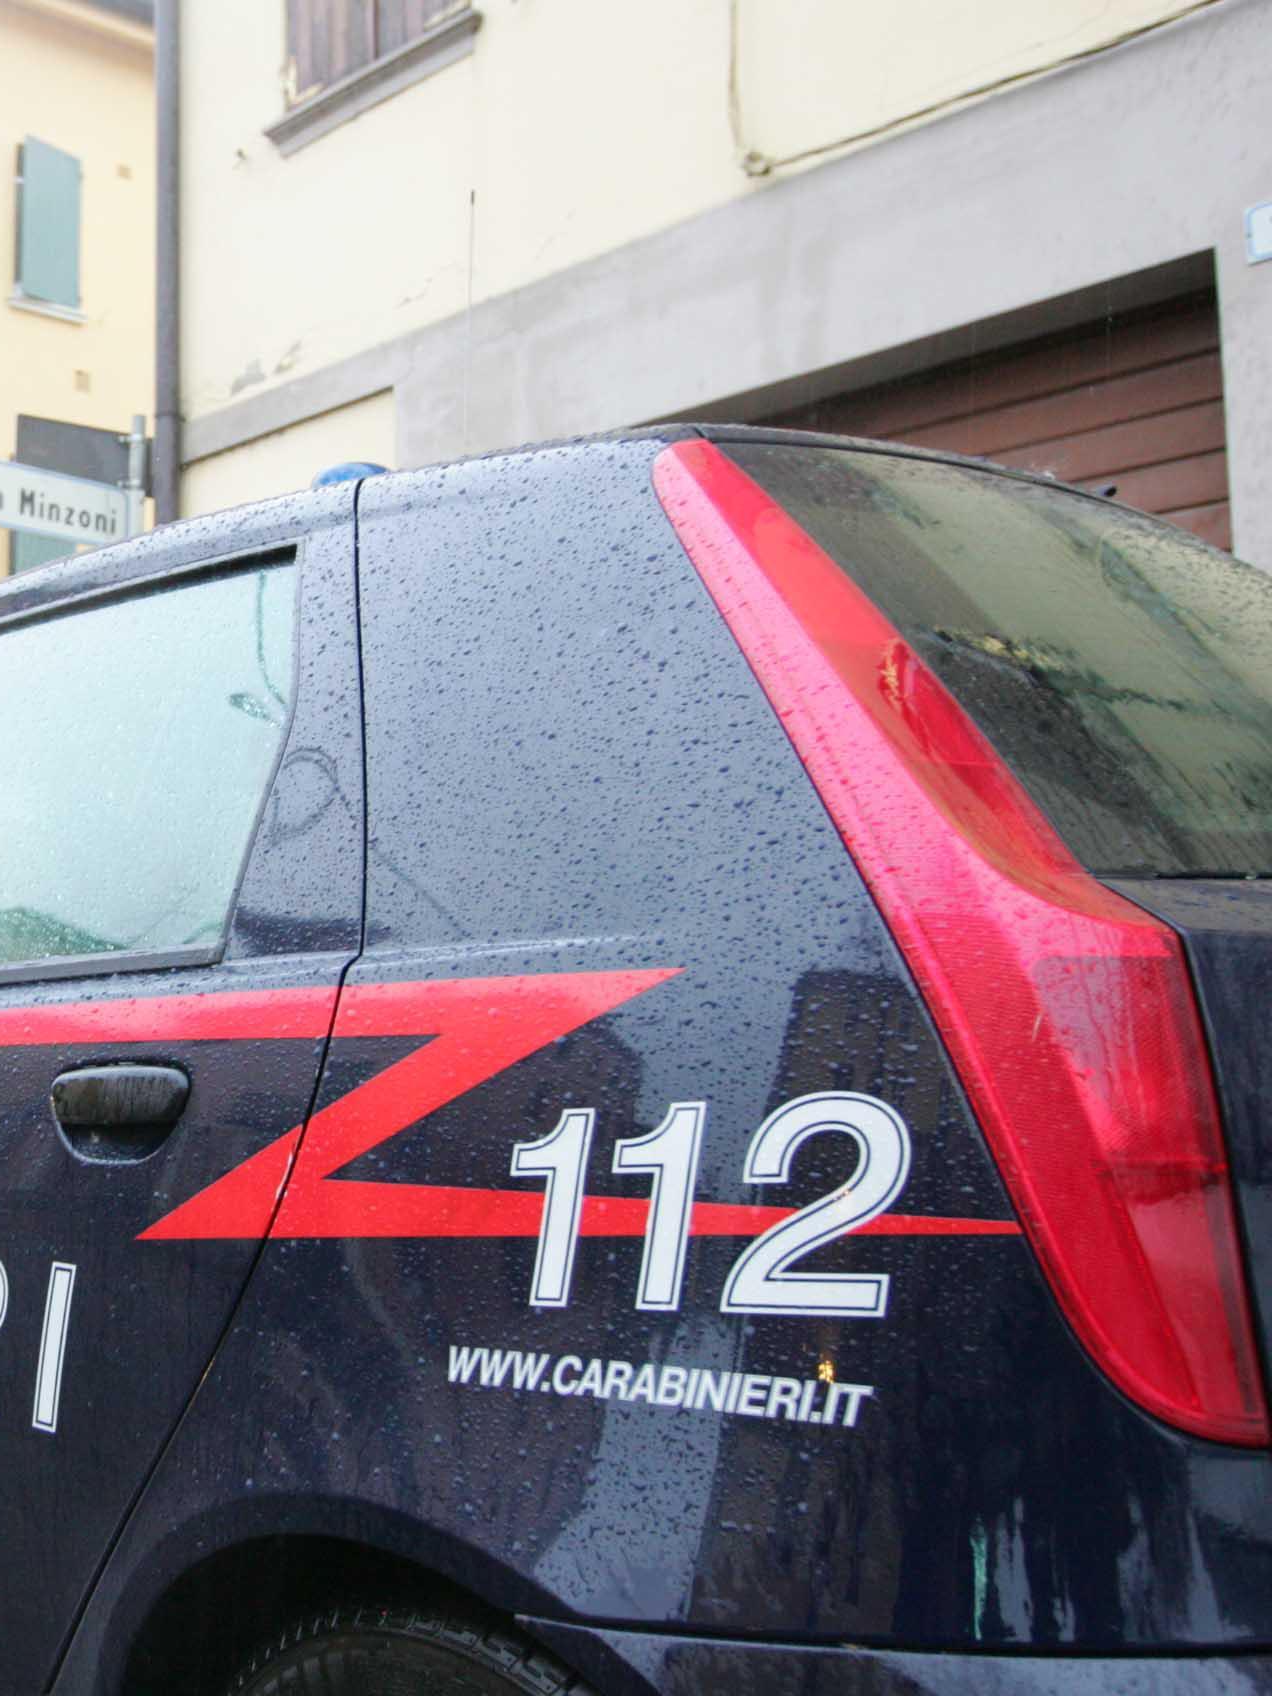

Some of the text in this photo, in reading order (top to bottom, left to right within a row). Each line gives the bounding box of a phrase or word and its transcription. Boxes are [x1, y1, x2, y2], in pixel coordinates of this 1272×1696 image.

[19, 487, 117, 534] Minzoni
[510, 1090, 912, 1318] 112
[447, 1345, 874, 1428] WWW.CARABINIERI.IT
